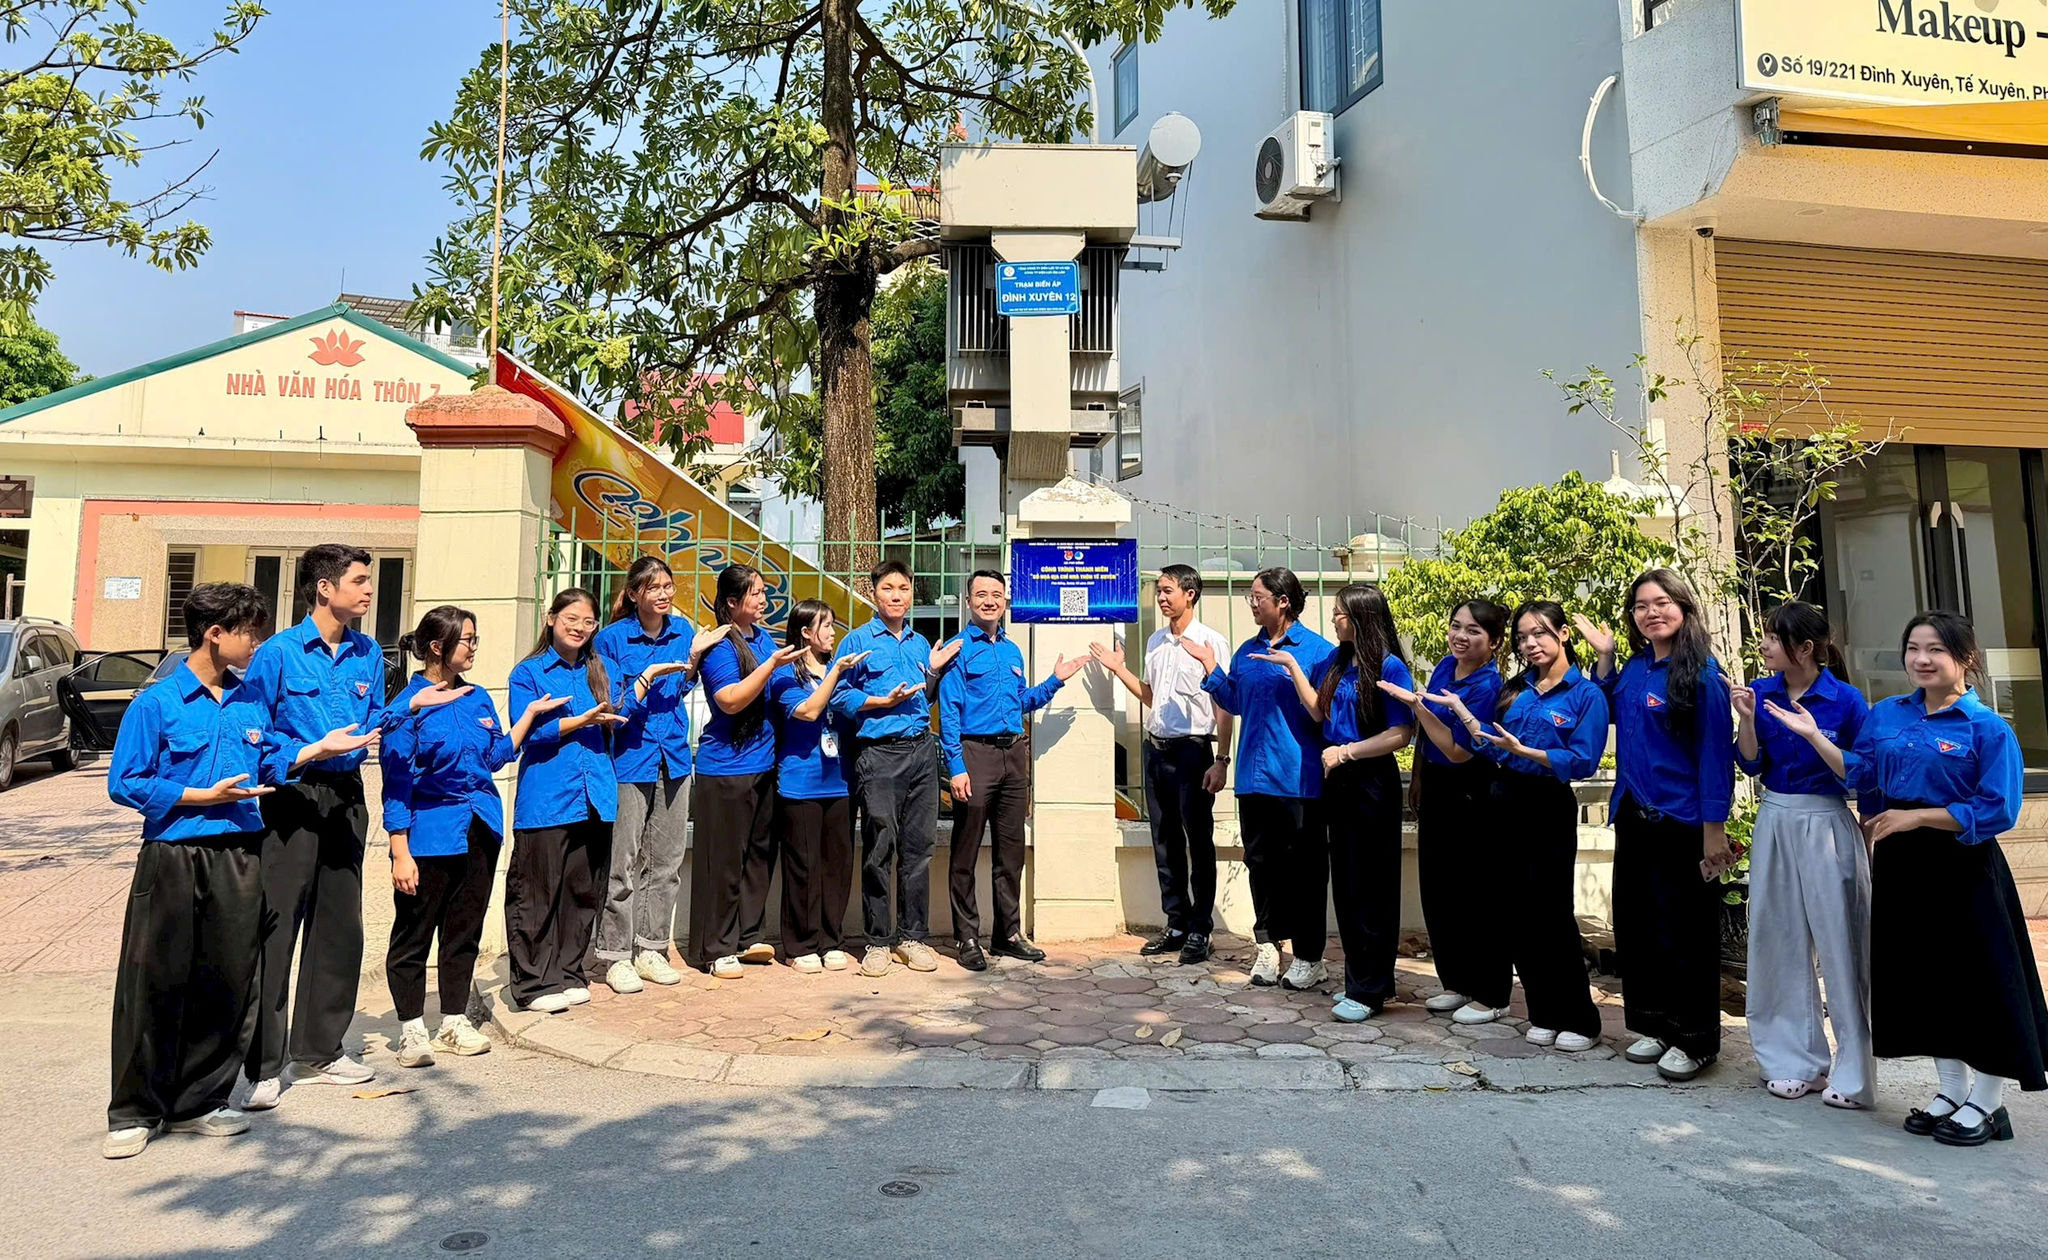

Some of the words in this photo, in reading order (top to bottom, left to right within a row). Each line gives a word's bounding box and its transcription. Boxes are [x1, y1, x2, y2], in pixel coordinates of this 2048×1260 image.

[1876, 0, 2026, 58] Makeup
[1781, 55, 1803, 73] Số
[1806, 59, 1856, 80] 19/221
[1860, 65, 1896, 84] Đình
[1901, 69, 1954, 94] Xuyên,
[1955, 73, 1974, 93] Tế
[1002, 292, 1026, 303] ĐÌNH
[1029, 291, 1063, 302] XUYÊN
[1065, 292, 1076, 301] 12
[1014, 281, 1034, 289] TRẠM
[1035, 280, 1051, 288] BIẾN
[1052, 280, 1062, 288] ÁP
[226, 369, 267, 396] NHÀ
[278, 370, 316, 399] VĂN
[325, 373, 362, 401] HÓA
[373, 377, 421, 404] THÔN
